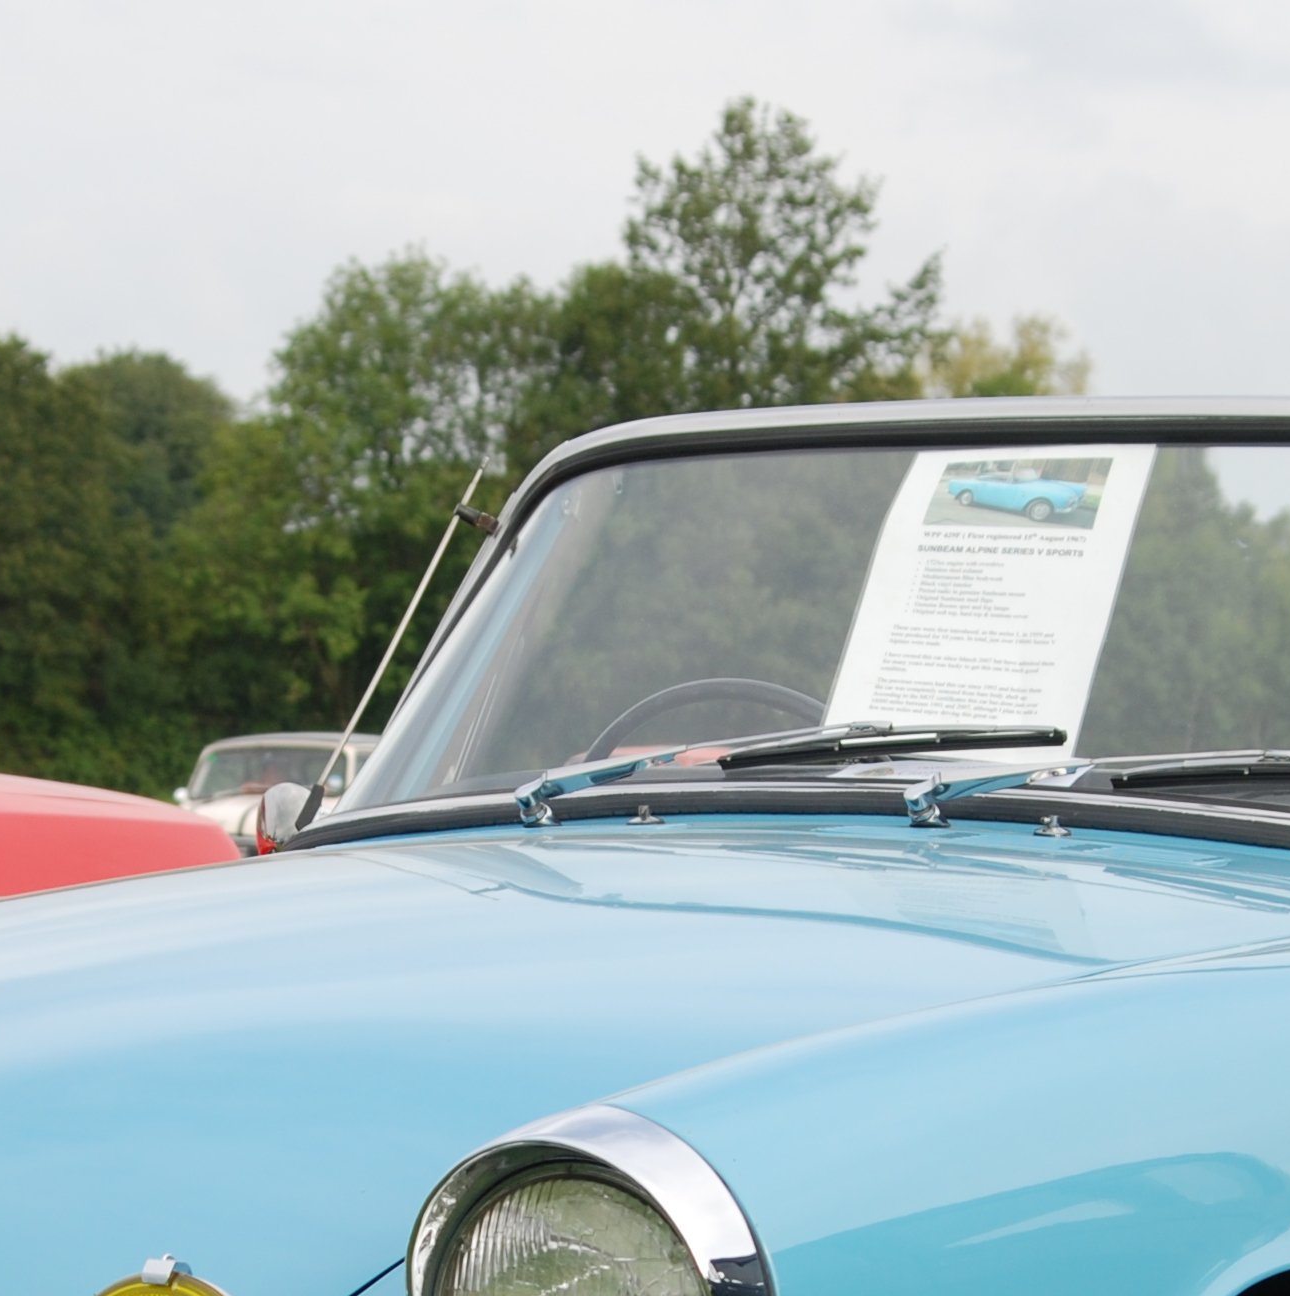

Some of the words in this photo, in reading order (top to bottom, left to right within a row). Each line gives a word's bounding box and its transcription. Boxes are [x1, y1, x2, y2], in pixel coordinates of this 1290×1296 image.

[985, 533, 1023, 541] registered
[917, 544, 964, 554] SUNBEAM
[964, 546, 999, 555] ALPINE
[1001, 547, 1035, 556] SERIES
[1037, 548, 1045, 556] V
[1045, 549, 1085, 558] SPORTS
